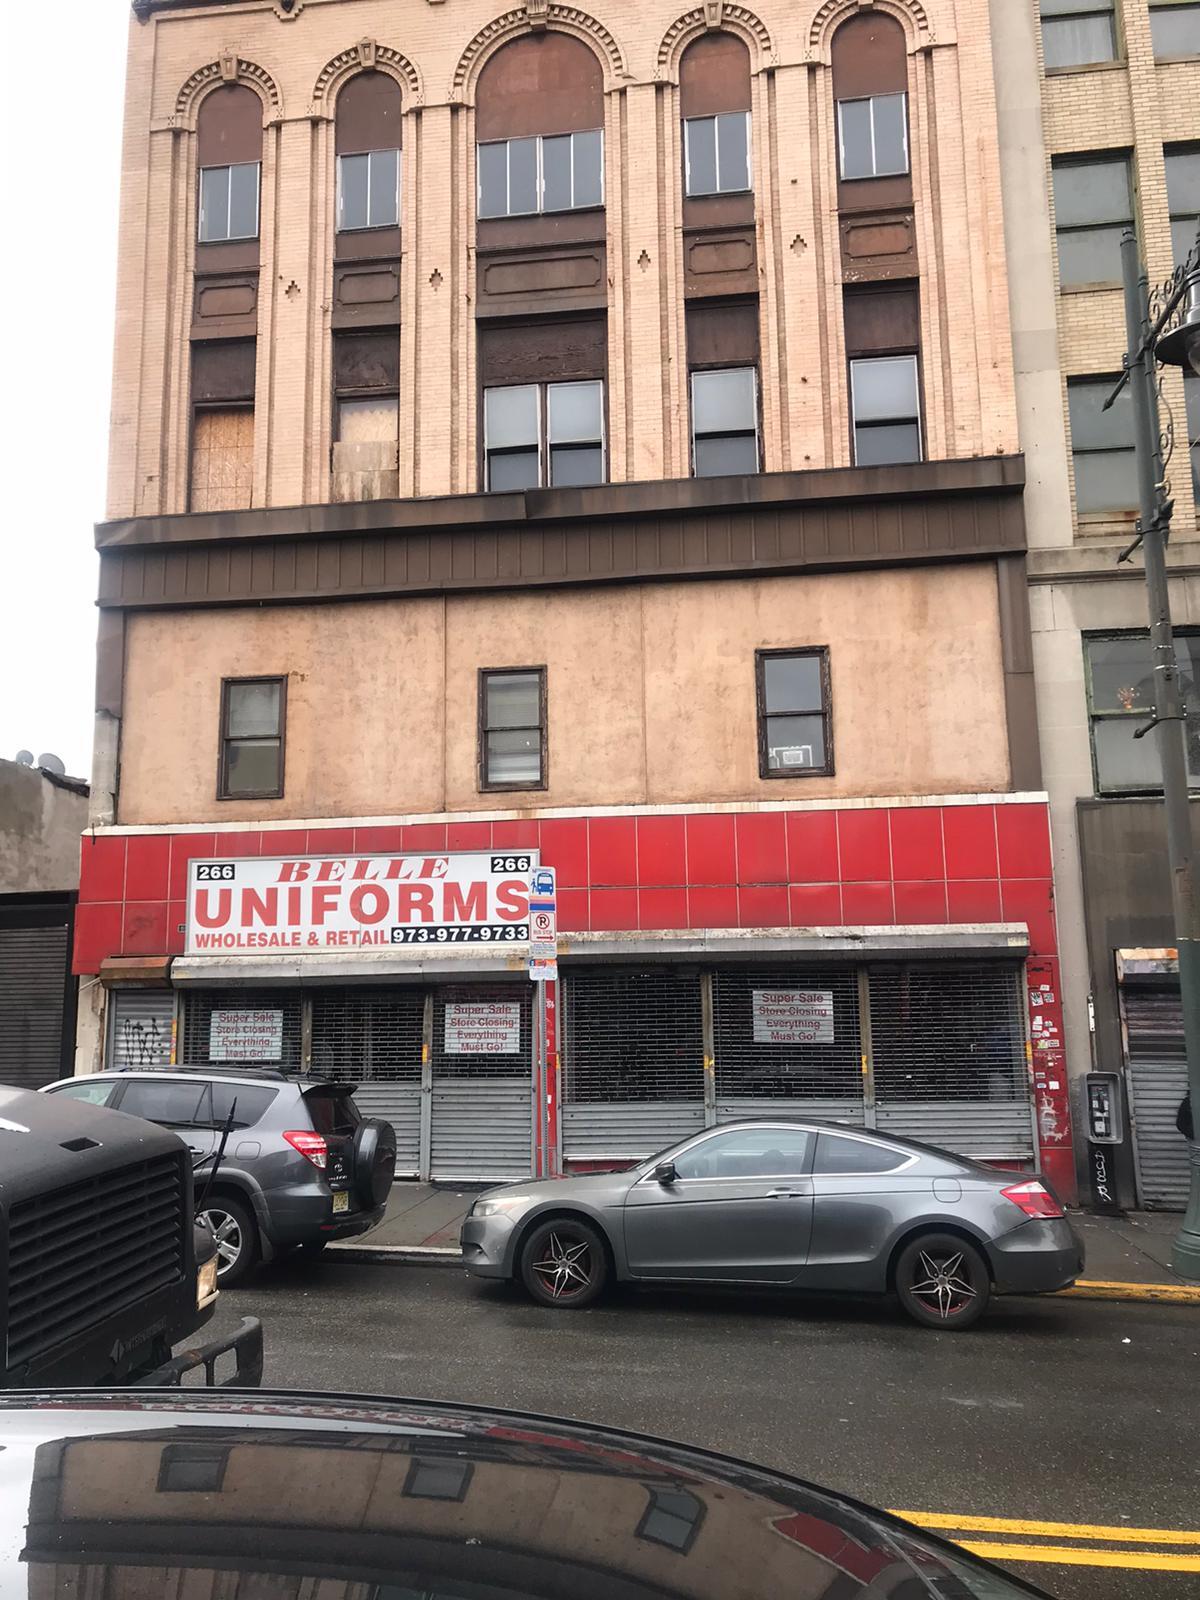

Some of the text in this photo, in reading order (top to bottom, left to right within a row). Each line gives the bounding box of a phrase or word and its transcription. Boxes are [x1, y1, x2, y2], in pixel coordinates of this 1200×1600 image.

[276, 857, 450, 882] BELLE
[492, 857, 529, 872] 266
[198, 866, 234, 880] 266
[194, 880, 530, 928] UNIFORMS
[195, 928, 389, 948] WHOLESALE & RETAIL
[392, 926, 529, 943] 973-977-9733
[762, 992, 824, 1004] Super Sale
[454, 1004, 512, 1016] Super Sale
[759, 1006, 827, 1017] Store Closing
[219, 1012, 275, 1023] Super Sale
[451, 1018, 514, 1028] Store Closing
[216, 1025, 277, 1036] Store Closing
[767, 1020, 820, 1030] Everything
[457, 1031, 507, 1040] Everything
[771, 1032, 816, 1040] Must Go!
[222, 1038, 270, 1047] Everything
[461, 1043, 503, 1051] Must Go!
